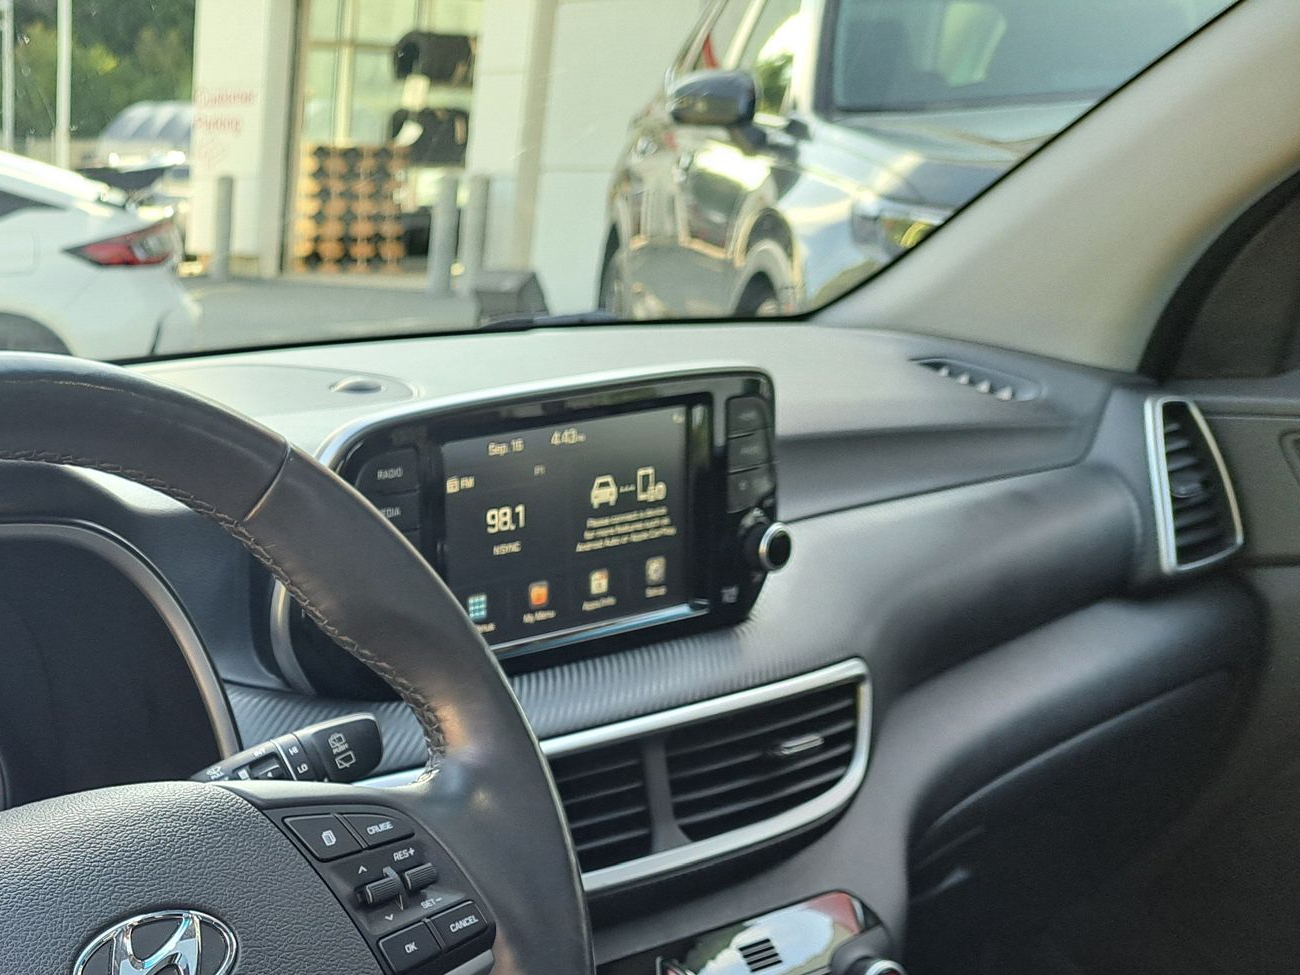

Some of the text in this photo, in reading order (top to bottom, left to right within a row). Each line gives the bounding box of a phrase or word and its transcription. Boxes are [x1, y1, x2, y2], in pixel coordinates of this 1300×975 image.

[377, 467, 403, 480] RADIO
[380, 506, 401, 519] EDIA
[486, 504, 525, 534] 98.1
[367, 821, 394, 835] CRUISE
[449, 914, 479, 933] CANCEL
[404, 941, 418, 954] OK
